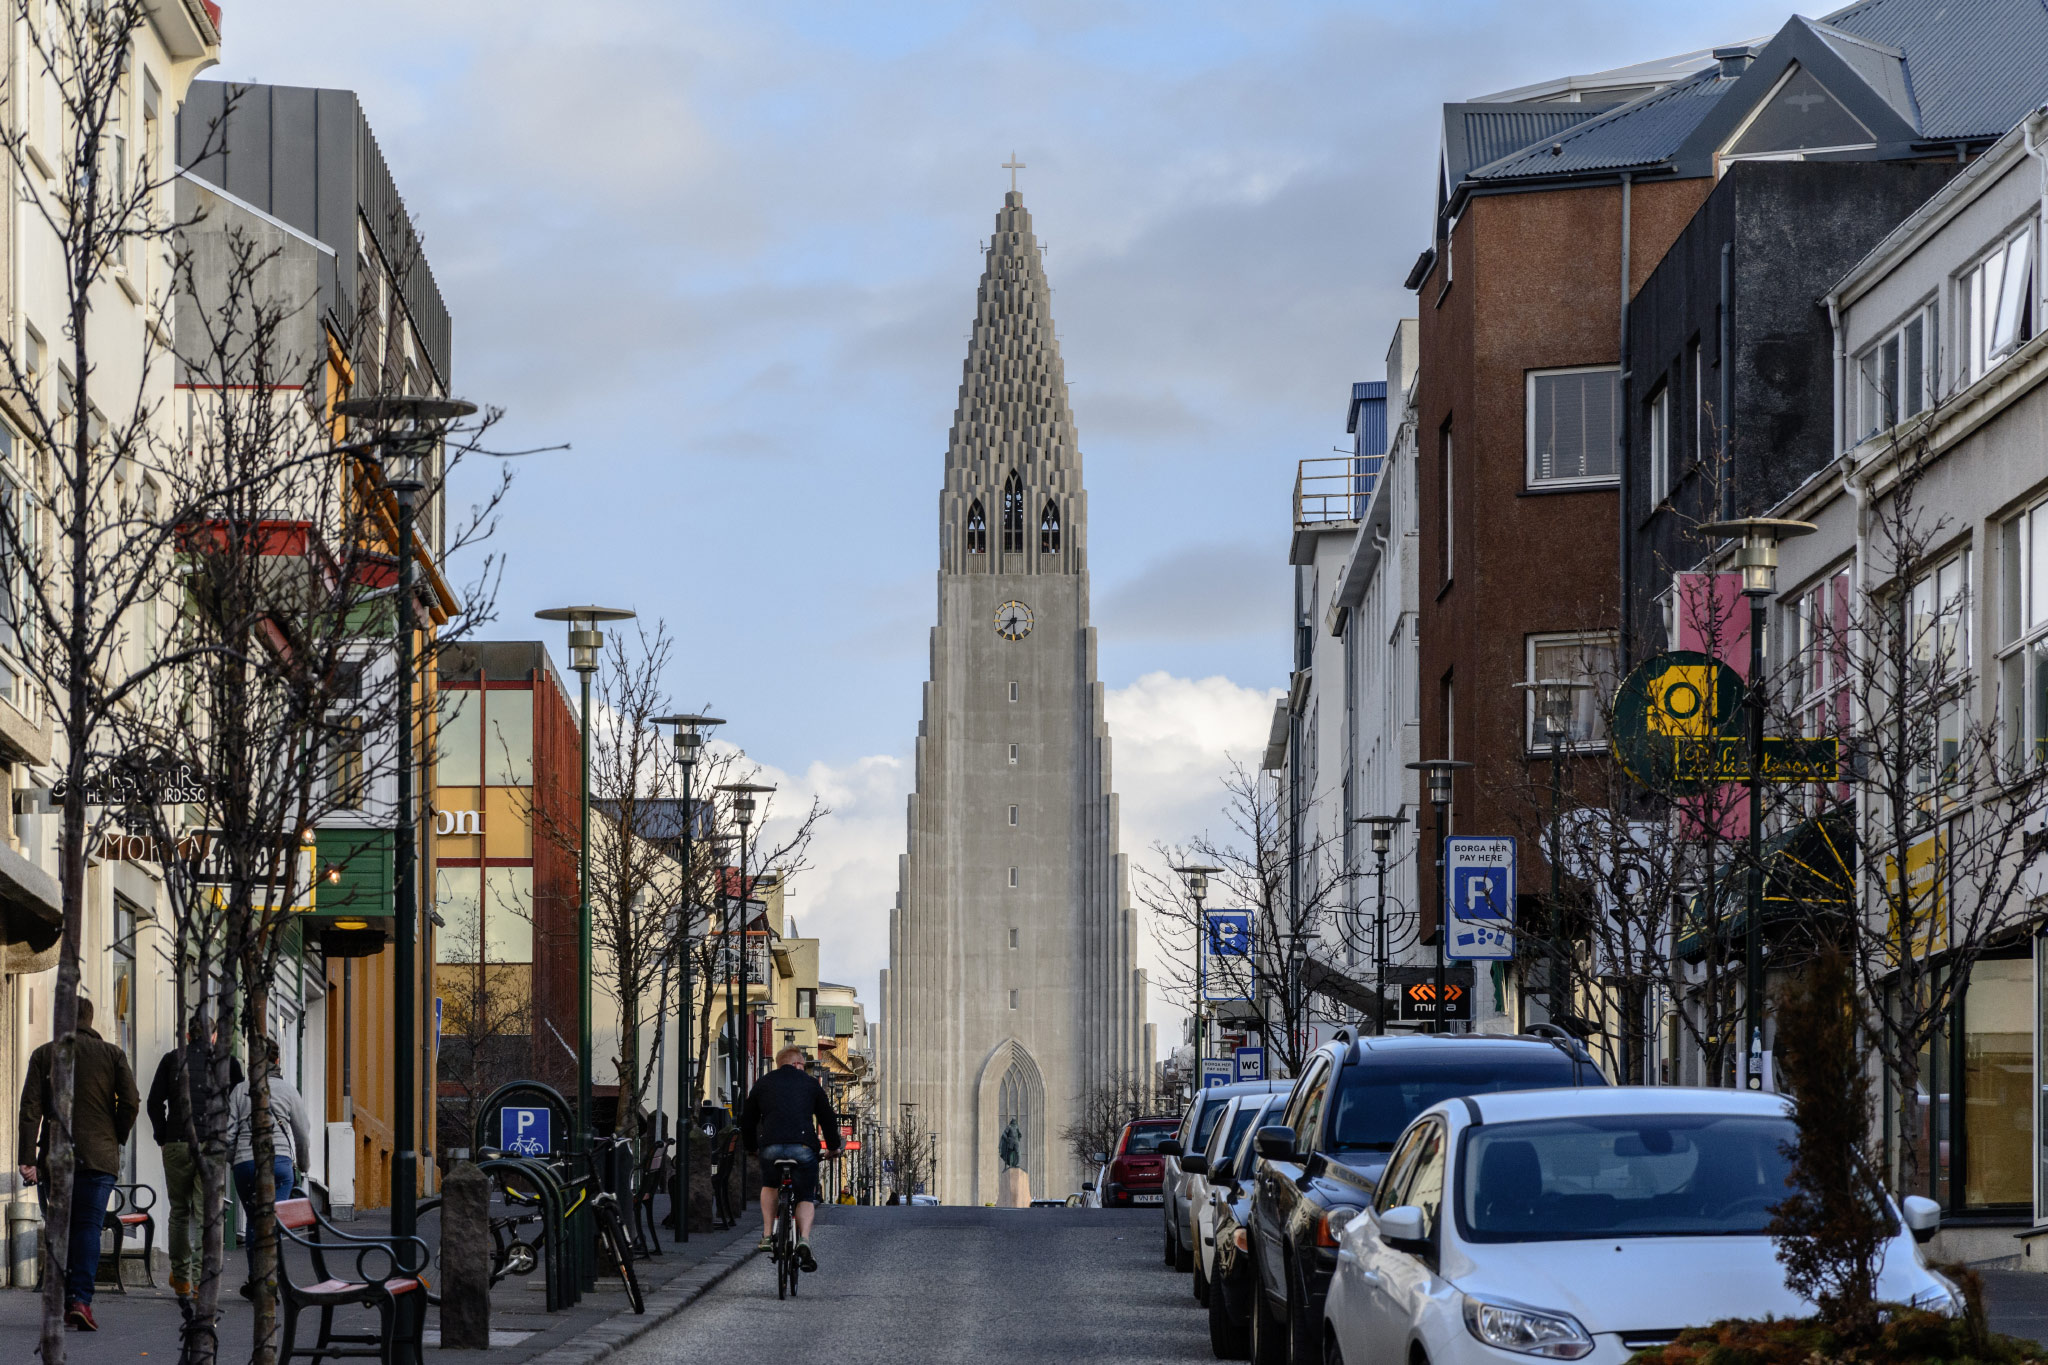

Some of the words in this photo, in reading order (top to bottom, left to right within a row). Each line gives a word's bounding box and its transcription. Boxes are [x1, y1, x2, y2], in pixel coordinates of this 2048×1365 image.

[1478, 854, 1503, 862] HERE
[1467, 876, 1494, 910] P
[1414, 1003, 1457, 1011] mia
[1241, 1061, 1259, 1070] WC
[517, 1110, 535, 1135] P
